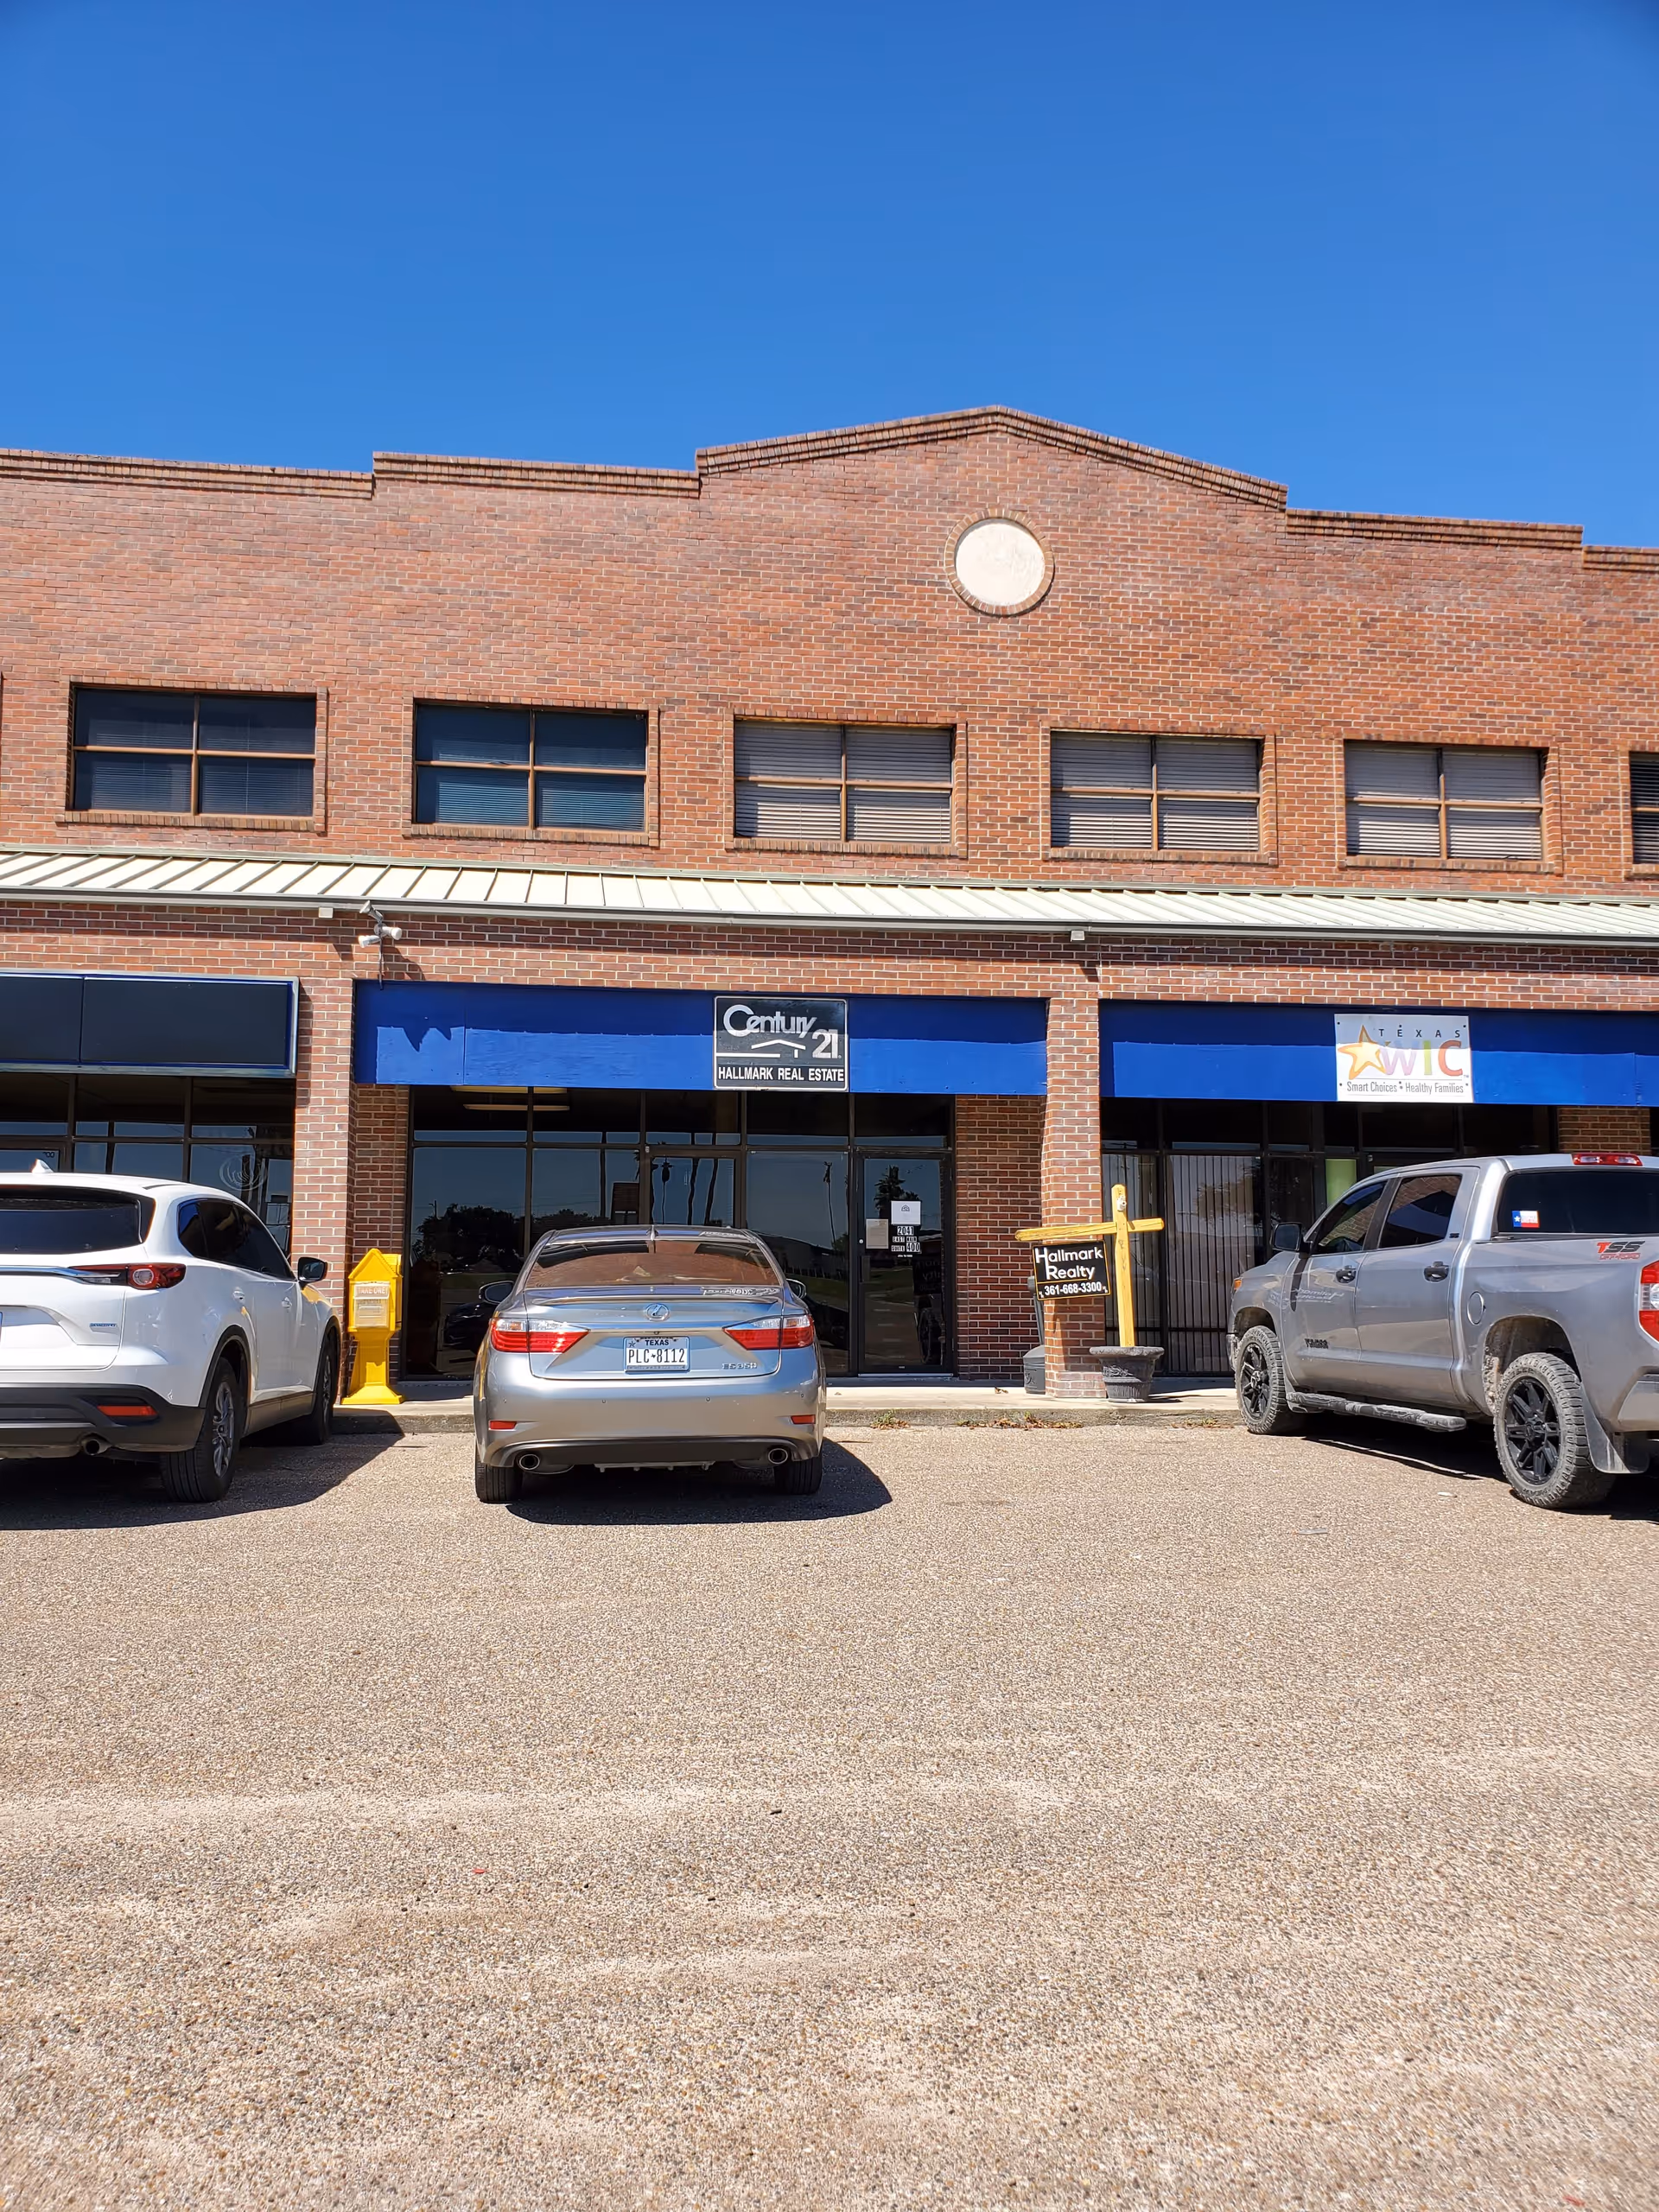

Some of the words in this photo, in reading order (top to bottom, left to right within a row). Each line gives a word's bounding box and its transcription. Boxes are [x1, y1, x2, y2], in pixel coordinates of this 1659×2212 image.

[723, 1004, 817, 1039] Century
[811, 1028, 839, 1059] 21
[1378, 1028, 1460, 1038] TEXAS
[1380, 1039, 1463, 1077] WIC
[718, 1066, 773, 1080] HALLMARK
[778, 1067, 804, 1081] REAL
[808, 1068, 844, 1082] ESTATE
[1346, 1081, 1369, 1092] Smart
[1370, 1082, 1397, 1092] Choices
[1405, 1083, 1433, 1095] Healthy
[1434, 1083, 1464, 1094] Families
[897, 1226, 914, 1236] 2041
[906, 1243, 920, 1252] 400
[1034, 1246, 1103, 1264] Hallmark
[1597, 1241, 1645, 1254] TSS
[1046, 1264, 1096, 1280] Realty
[1044, 1281, 1102, 1296] 361-668-3300
